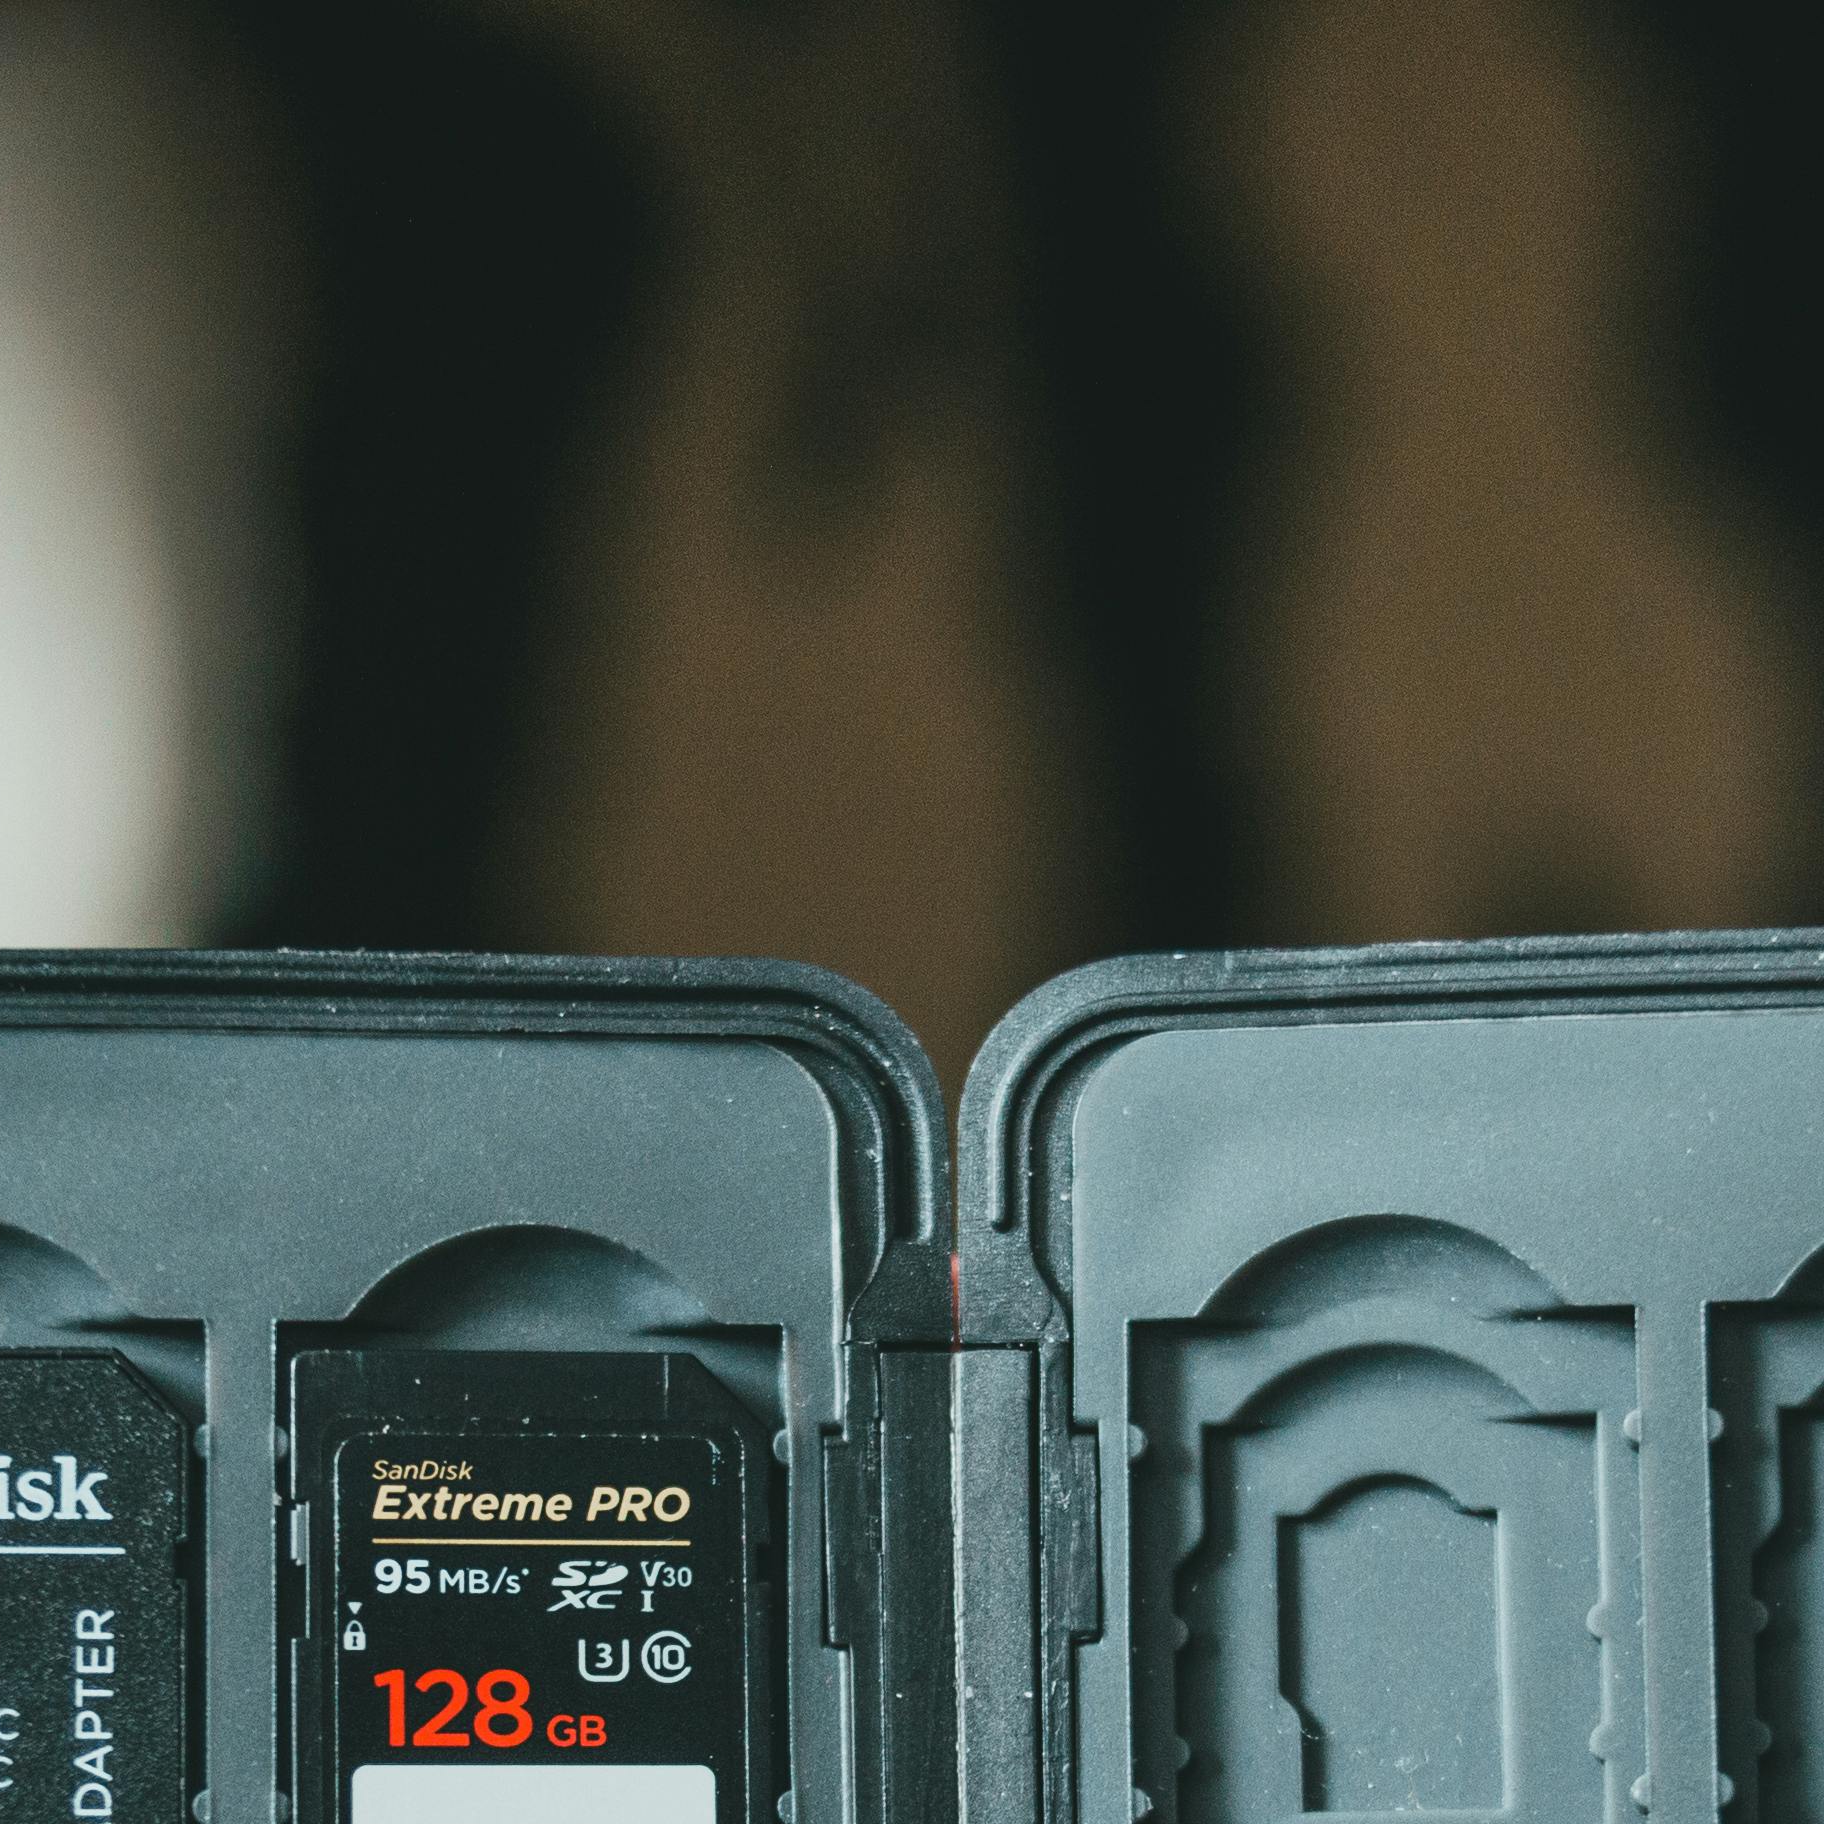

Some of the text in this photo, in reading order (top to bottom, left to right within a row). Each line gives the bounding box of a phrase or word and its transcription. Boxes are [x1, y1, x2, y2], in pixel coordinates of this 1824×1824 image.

[371, 1459, 474, 1482] SanDisk
[371, 1484, 692, 1524] Extreme PRO
[373, 1557, 432, 1595] 95
[372, 1667, 608, 1749] 128 GB
